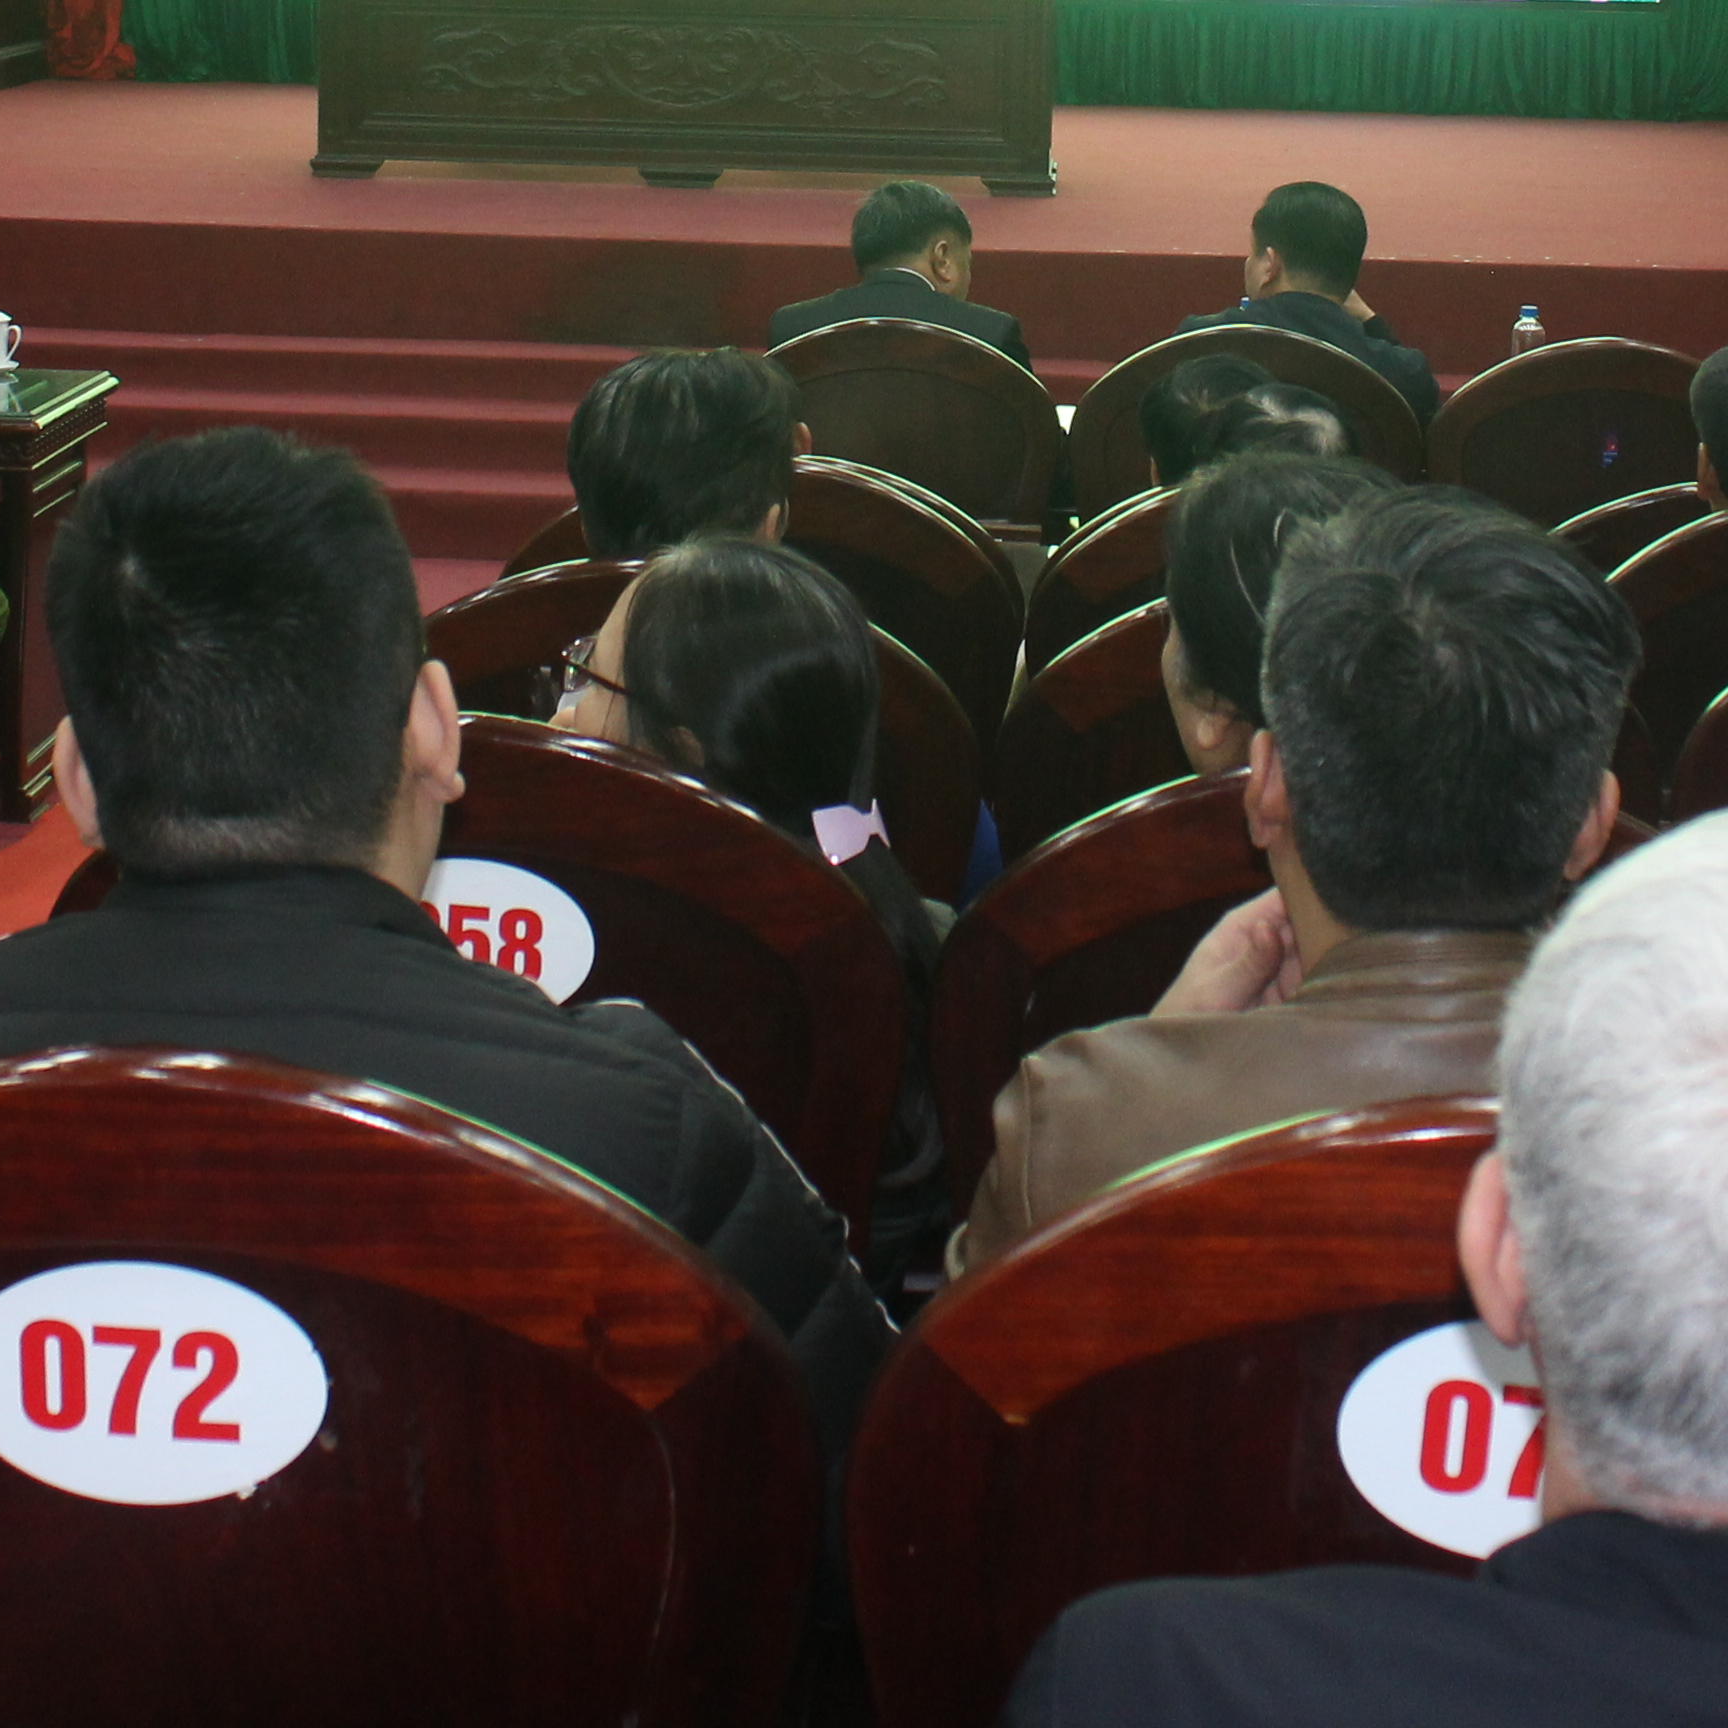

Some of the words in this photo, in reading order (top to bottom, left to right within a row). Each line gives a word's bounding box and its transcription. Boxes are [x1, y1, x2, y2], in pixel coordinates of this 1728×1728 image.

[422, 901, 543, 982] 58
[22, 1320, 239, 1440] 072
[1420, 1379, 1546, 1500] 07
